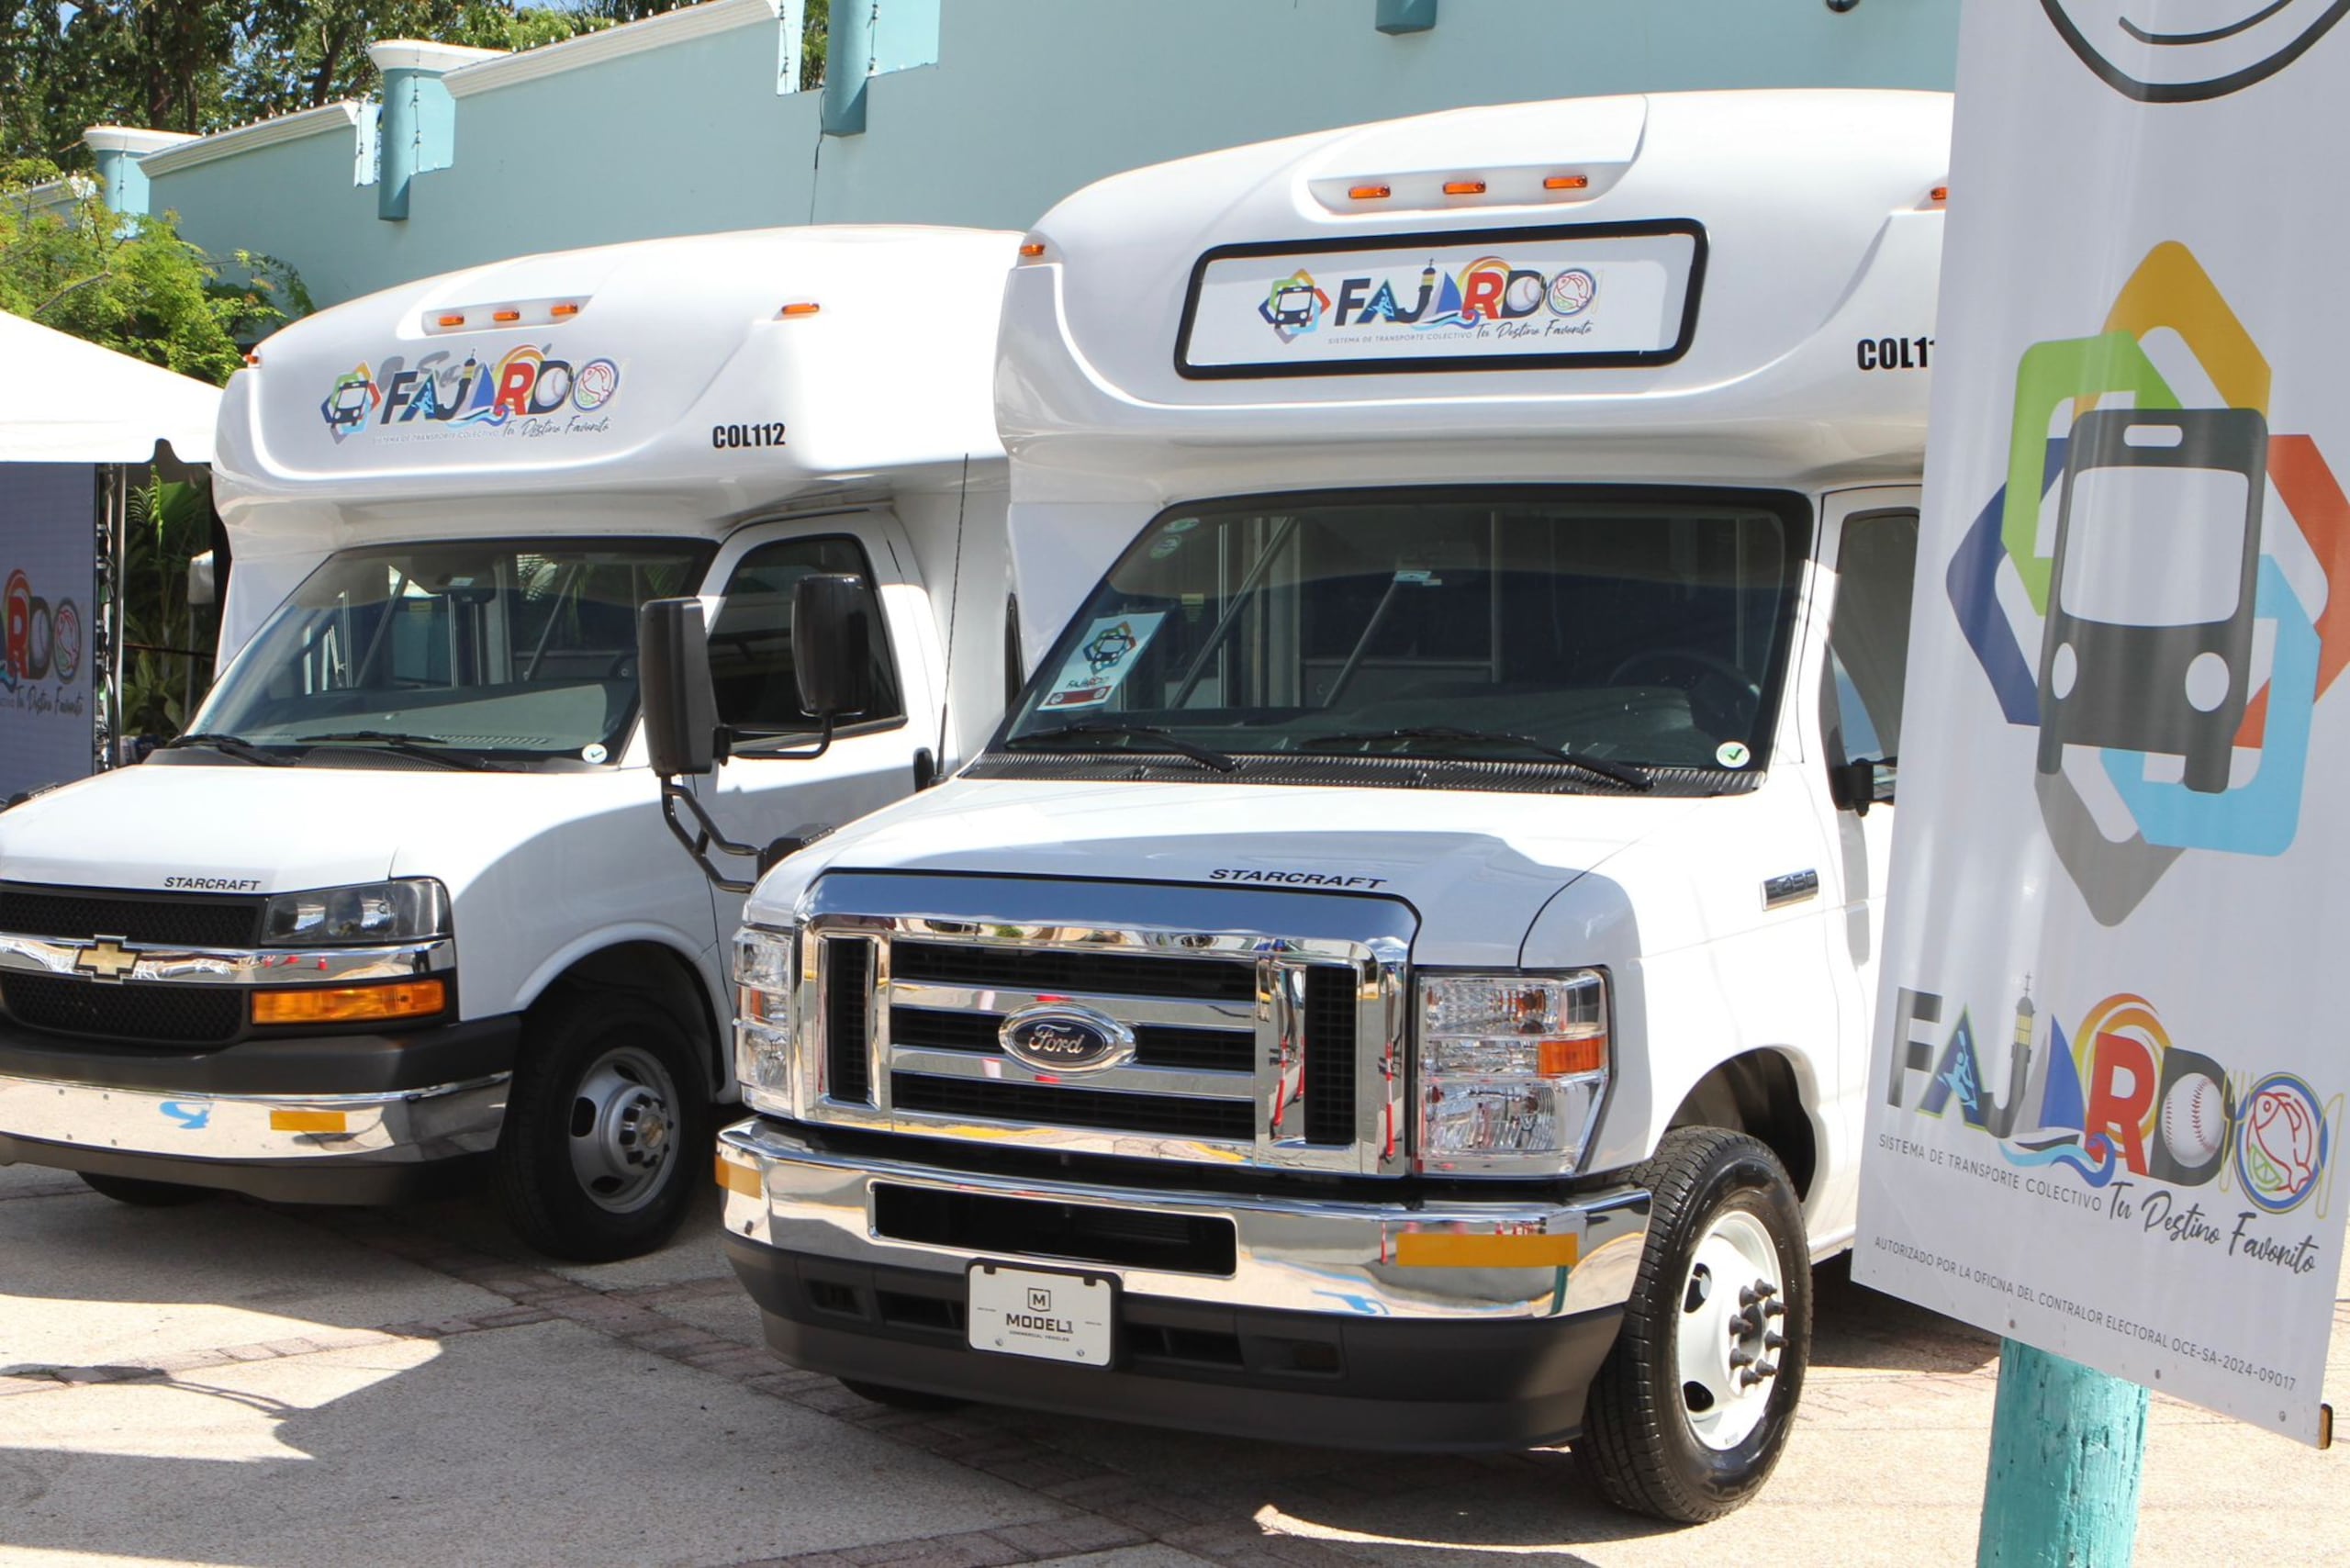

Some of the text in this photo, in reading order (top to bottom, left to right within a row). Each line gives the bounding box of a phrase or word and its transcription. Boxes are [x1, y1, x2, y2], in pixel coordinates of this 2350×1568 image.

[1334, 257, 1600, 328] FAJARDO
[1328, 319, 1595, 344] SISTEMA DE TRANSPORTE COLECTIVO Tu Destino Favorito
[1857, 337, 1935, 371] COL1
[712, 422, 786, 448] COL112
[164, 877, 262, 891] STARCRAFT
[1209, 868, 1387, 889] STARCRAFT
[1028, 1024, 1085, 1054] Ford
[1887, 973, 2343, 1218] FAJARDO
[1879, 1134, 2319, 1274] SISTEMA DE TRANSPORTE COLECTIVO Tu Destino Favorito
[1033, 1294, 1046, 1306] M
[1874, 1236, 2297, 1392] AUTORIZADO POR LA OFICINA DEL CONTRALOR ELECTORAL OCE-SA-2024-09017
[1006, 1313, 1074, 1334] MODEL1
